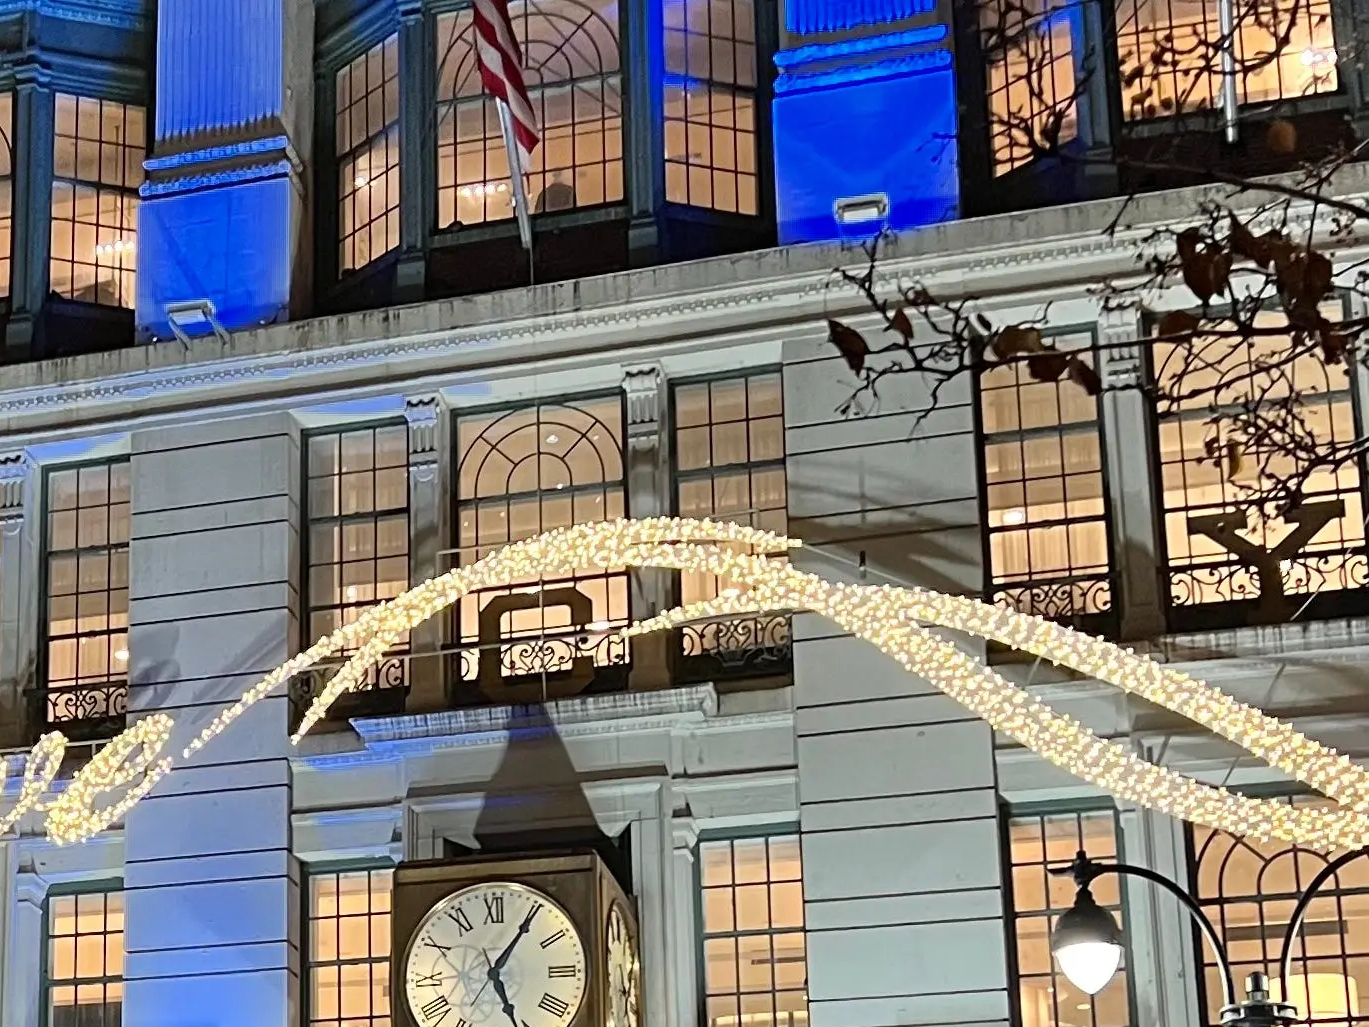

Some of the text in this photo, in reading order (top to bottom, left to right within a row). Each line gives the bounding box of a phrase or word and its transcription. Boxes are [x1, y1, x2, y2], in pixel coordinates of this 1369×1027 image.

[483, 896, 505, 926] XII
[448, 907, 474, 938] XI
[424, 936, 451, 958] X
[540, 929, 566, 950] II
[548, 965, 576, 978] III
